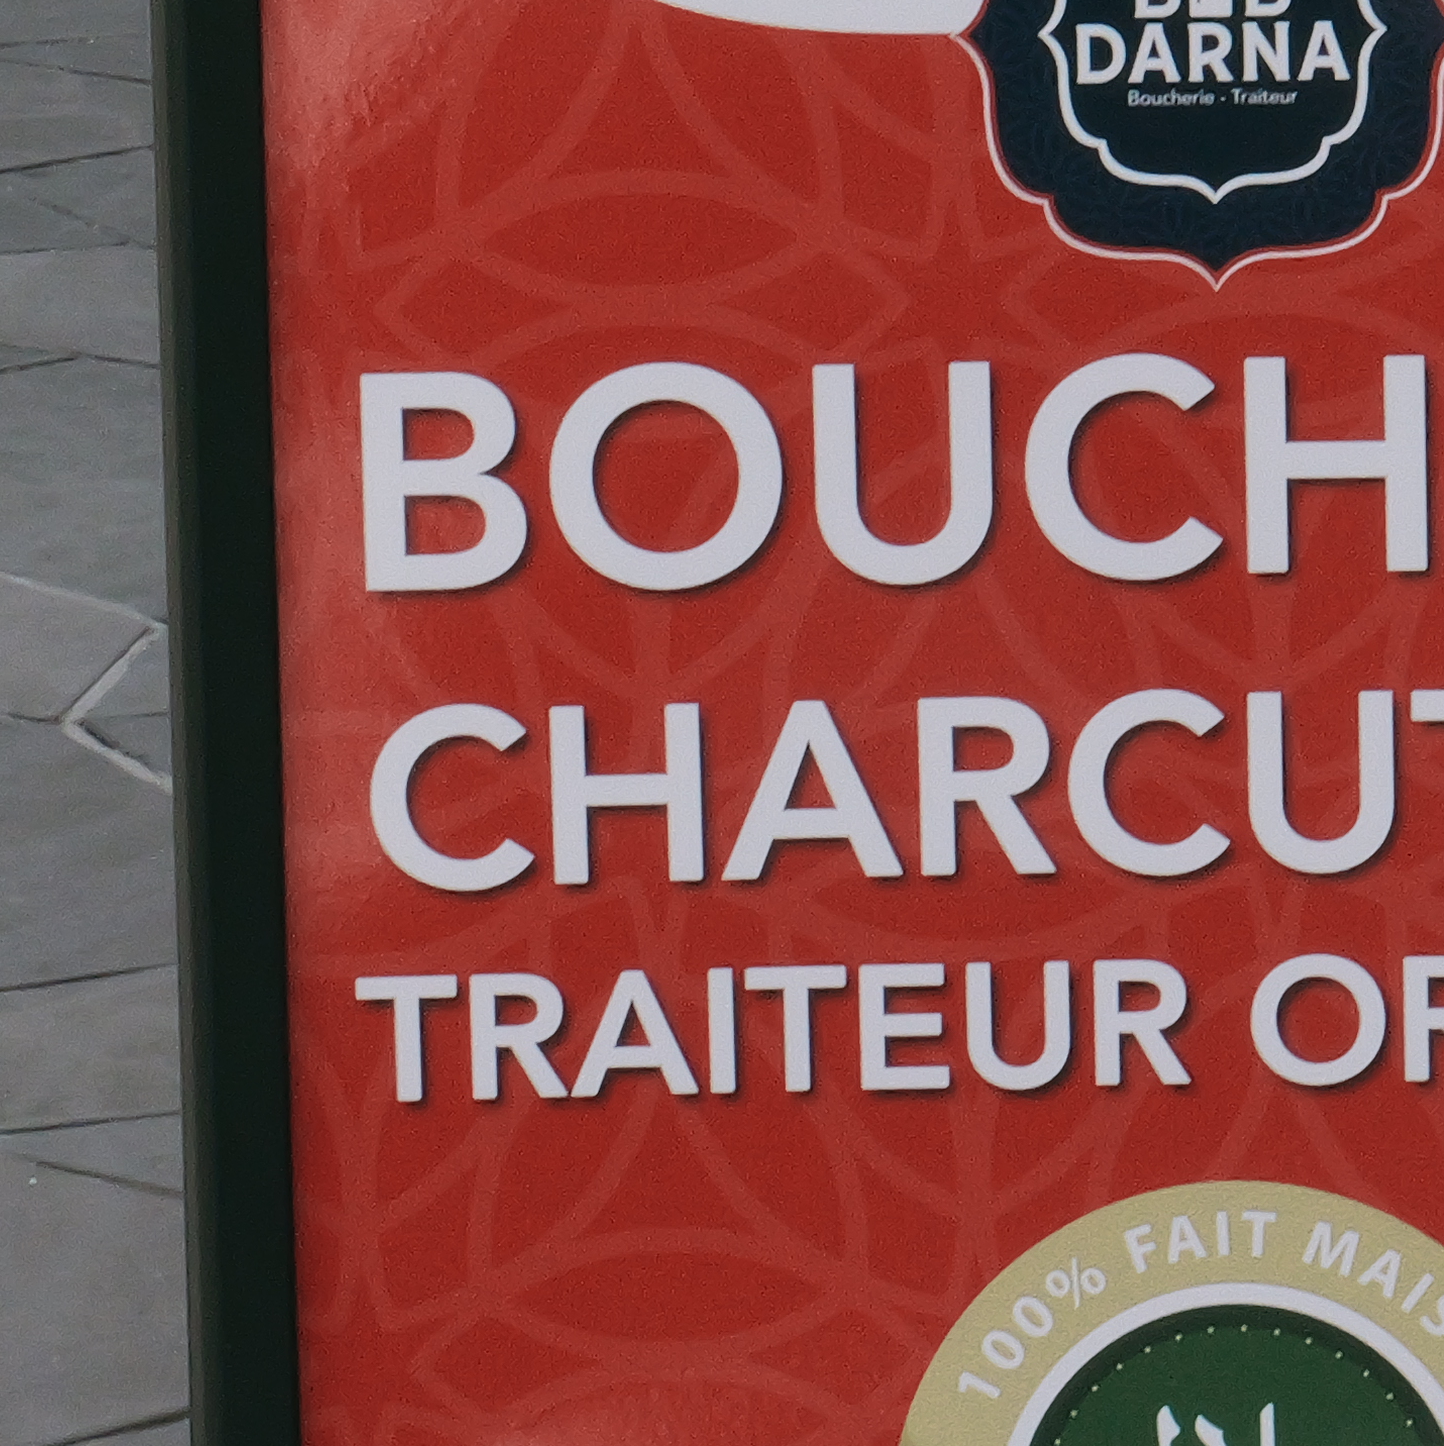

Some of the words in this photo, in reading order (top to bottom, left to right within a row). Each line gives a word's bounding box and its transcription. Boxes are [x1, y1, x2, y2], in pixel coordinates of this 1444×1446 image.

[1075, 19, 1351, 85] DARNA
[1127, 87, 1216, 107] Boucherie
[1230, 87, 1299, 106] Traiteur
[354, 960, 1192, 1103] TRAITEUR
[958, 1257, 1107, 1402] 100%
[1123, 1210, 1277, 1274] FAIT
